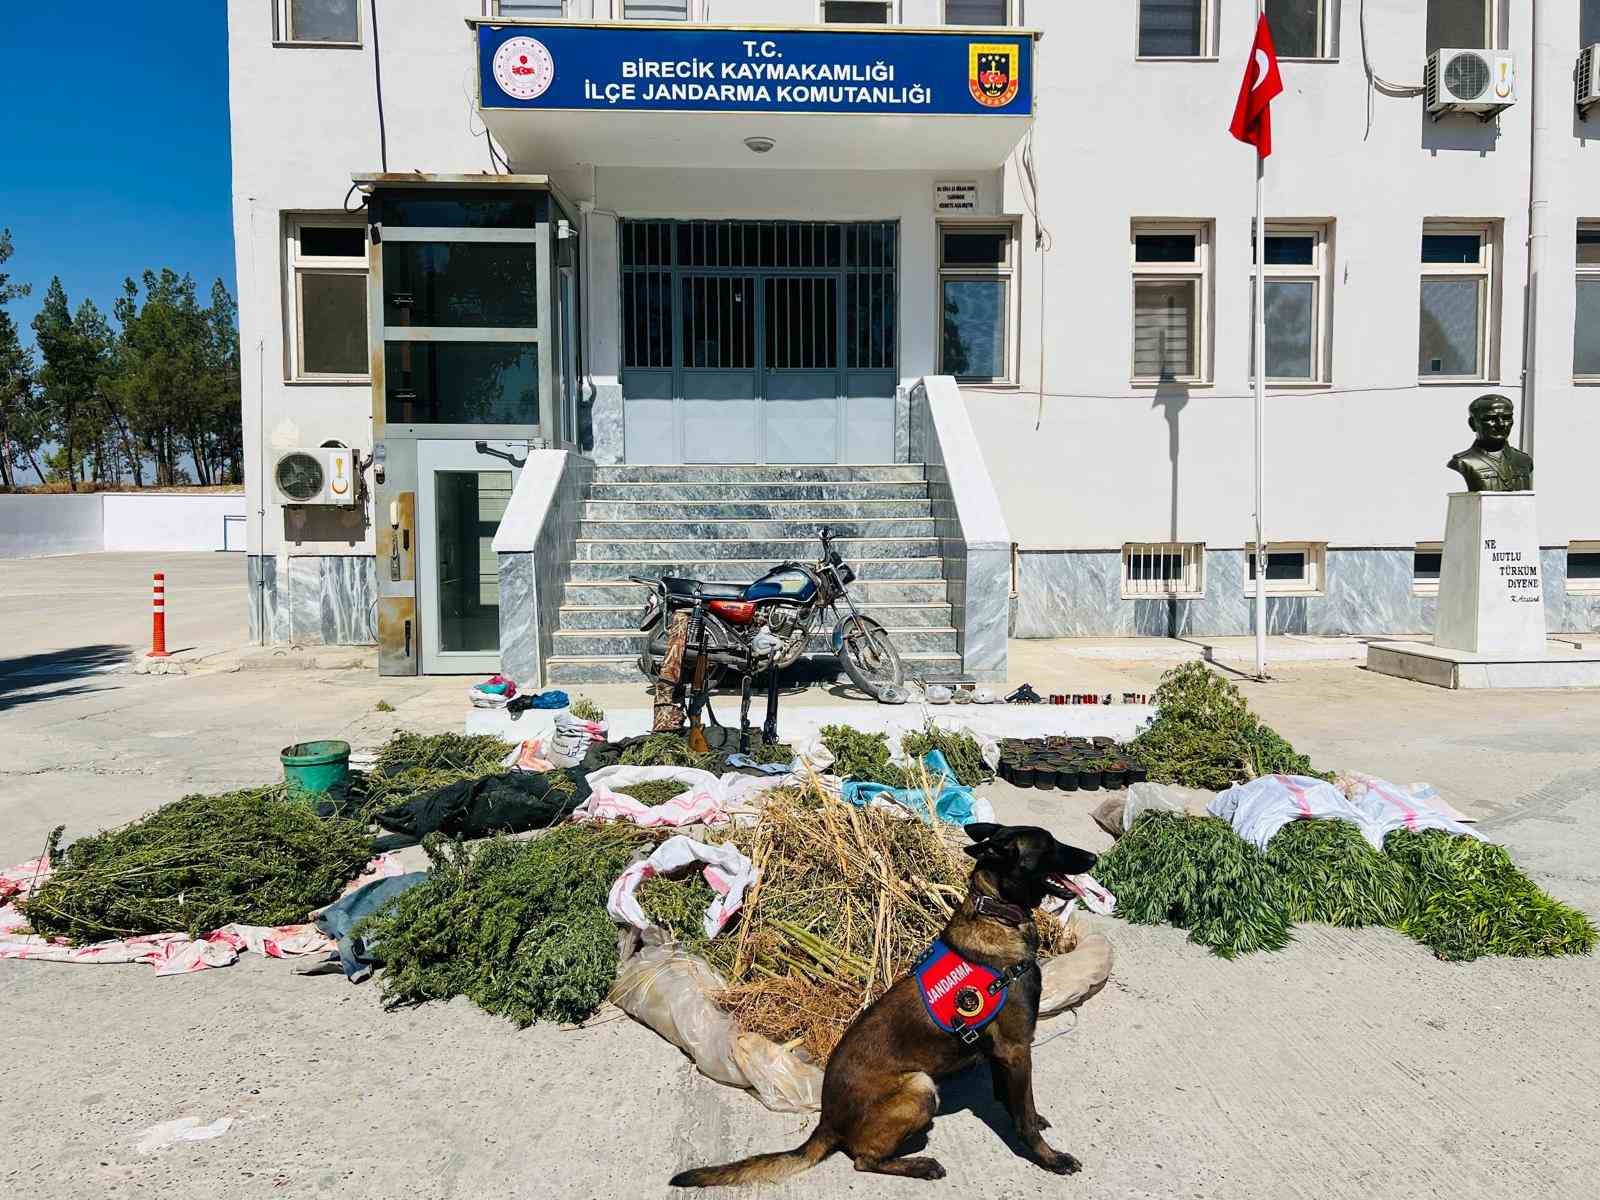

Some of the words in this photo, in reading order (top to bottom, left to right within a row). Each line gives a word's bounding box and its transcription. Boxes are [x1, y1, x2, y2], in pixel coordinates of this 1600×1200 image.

[742, 40, 782, 58] T.C.
[622, 57, 715, 78] BİRECİK
[721, 61, 895, 81] KAYMAKAMLIĞI
[585, 79, 636, 104] İLÇE
[642, 83, 771, 103] JANDARMA
[777, 84, 932, 104] KOMUTANLIĞI
[1484, 539, 1497, 550] NE
[1492, 551, 1522, 562] MUTLU
[926, 961, 974, 1005] JANDARMA
